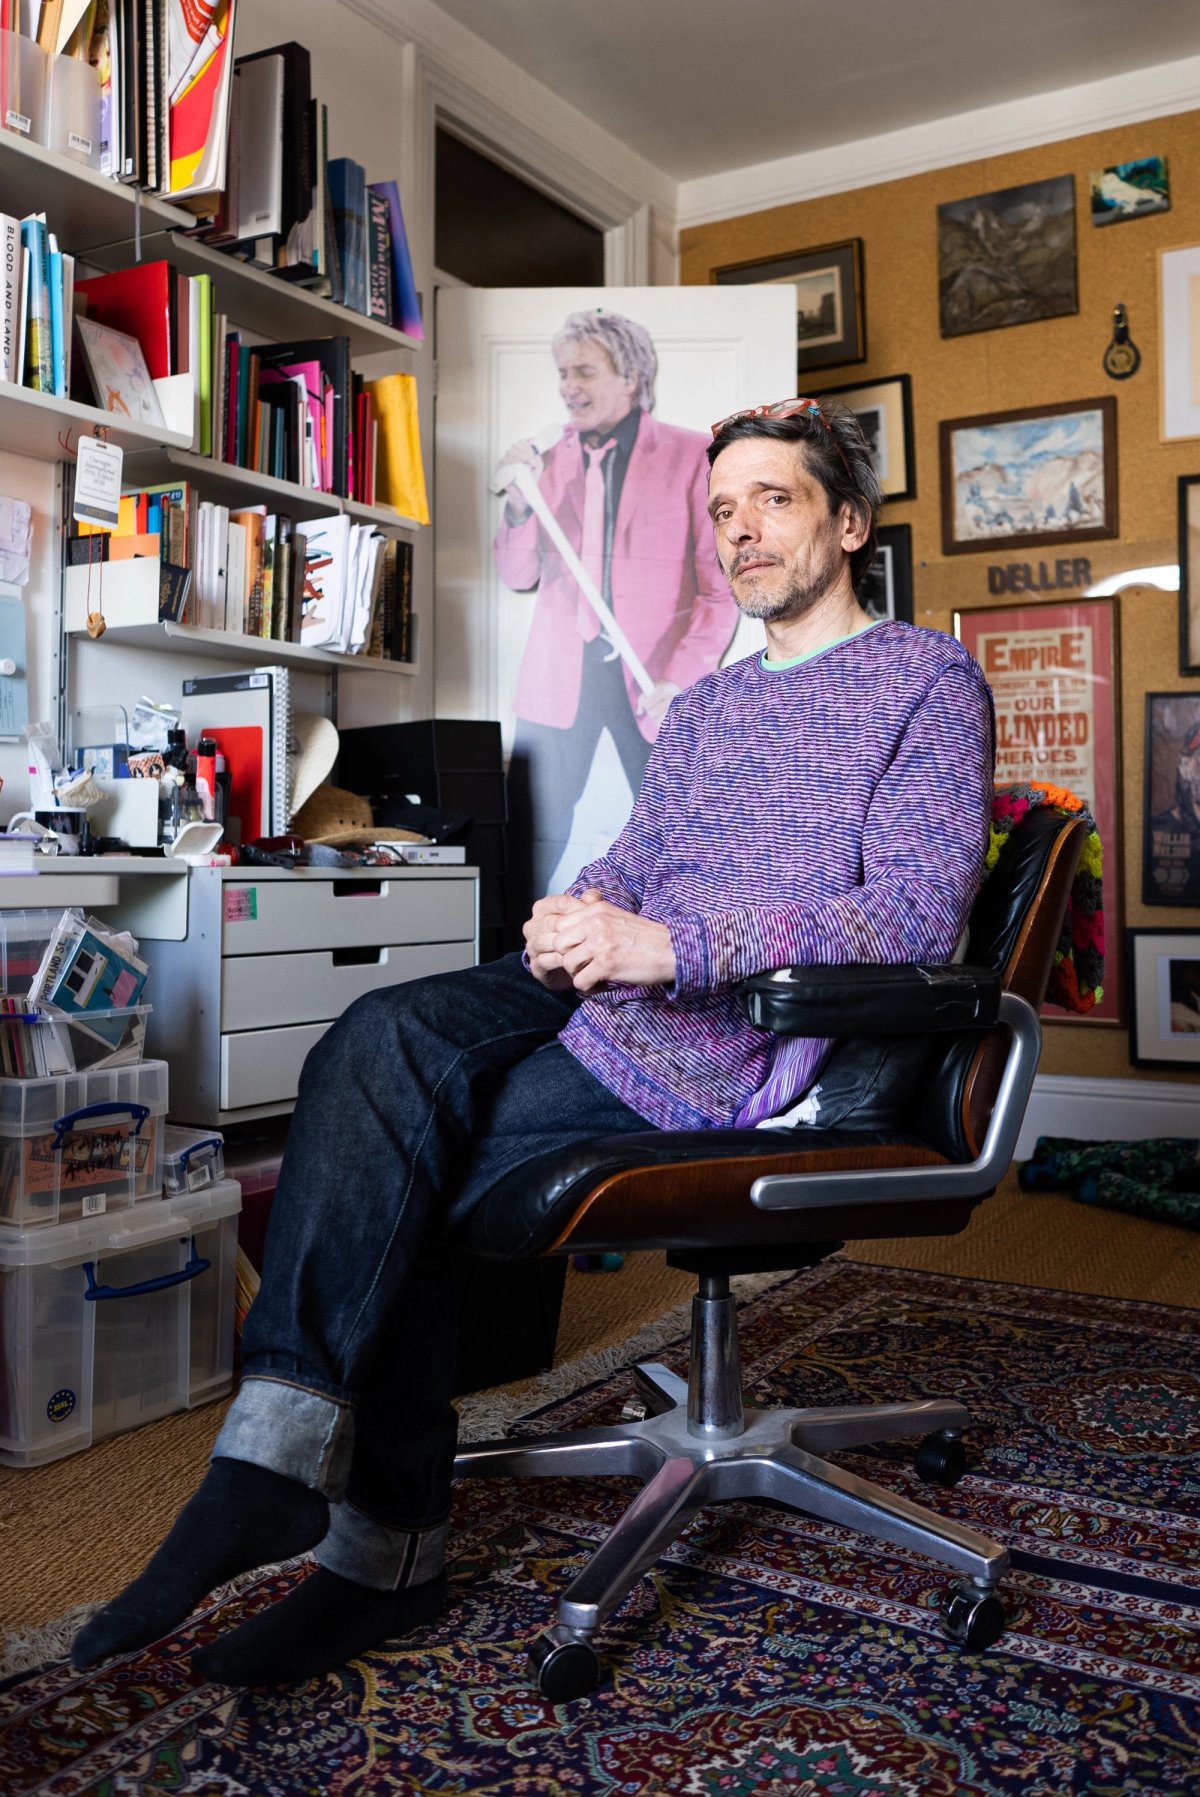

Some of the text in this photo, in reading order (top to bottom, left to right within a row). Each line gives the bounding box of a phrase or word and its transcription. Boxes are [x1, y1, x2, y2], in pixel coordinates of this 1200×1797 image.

[6, 226, 15, 272] BLOOD
[5, 280, 13, 310] AND
[371, 263, 386, 317] Boris
[988, 557, 1092, 595] DELLER
[985, 632, 1085, 673] EMPIRE
[1015, 696, 1055, 712] OUR
[994, 712, 1088, 748] LINDED
[996, 749, 1077, 765] HEROES
[40, 956, 62, 1001] PORTLAND
